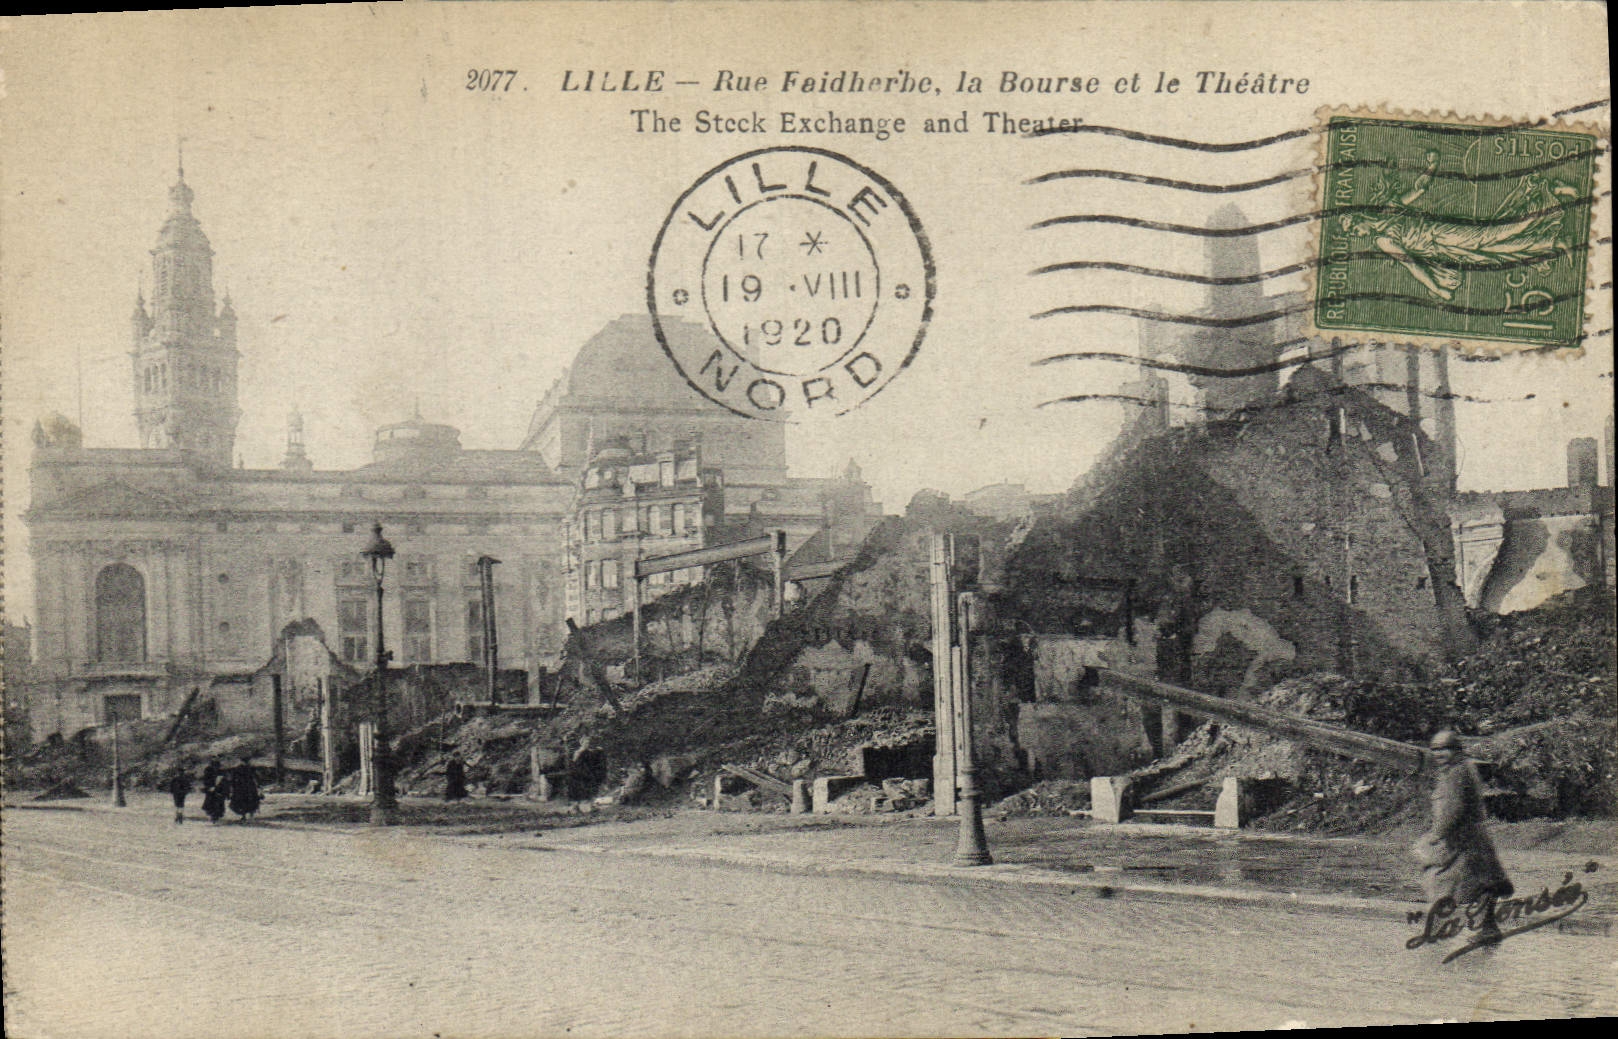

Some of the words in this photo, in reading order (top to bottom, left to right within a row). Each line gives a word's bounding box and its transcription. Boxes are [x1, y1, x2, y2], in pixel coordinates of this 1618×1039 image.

[688, 160, 888, 231] LILLE
[738, 233, 769, 260] 17
[722, 274, 762, 302] 19
[743, 317, 842, 346] 1920
[700, 350, 882, 408] NORD
